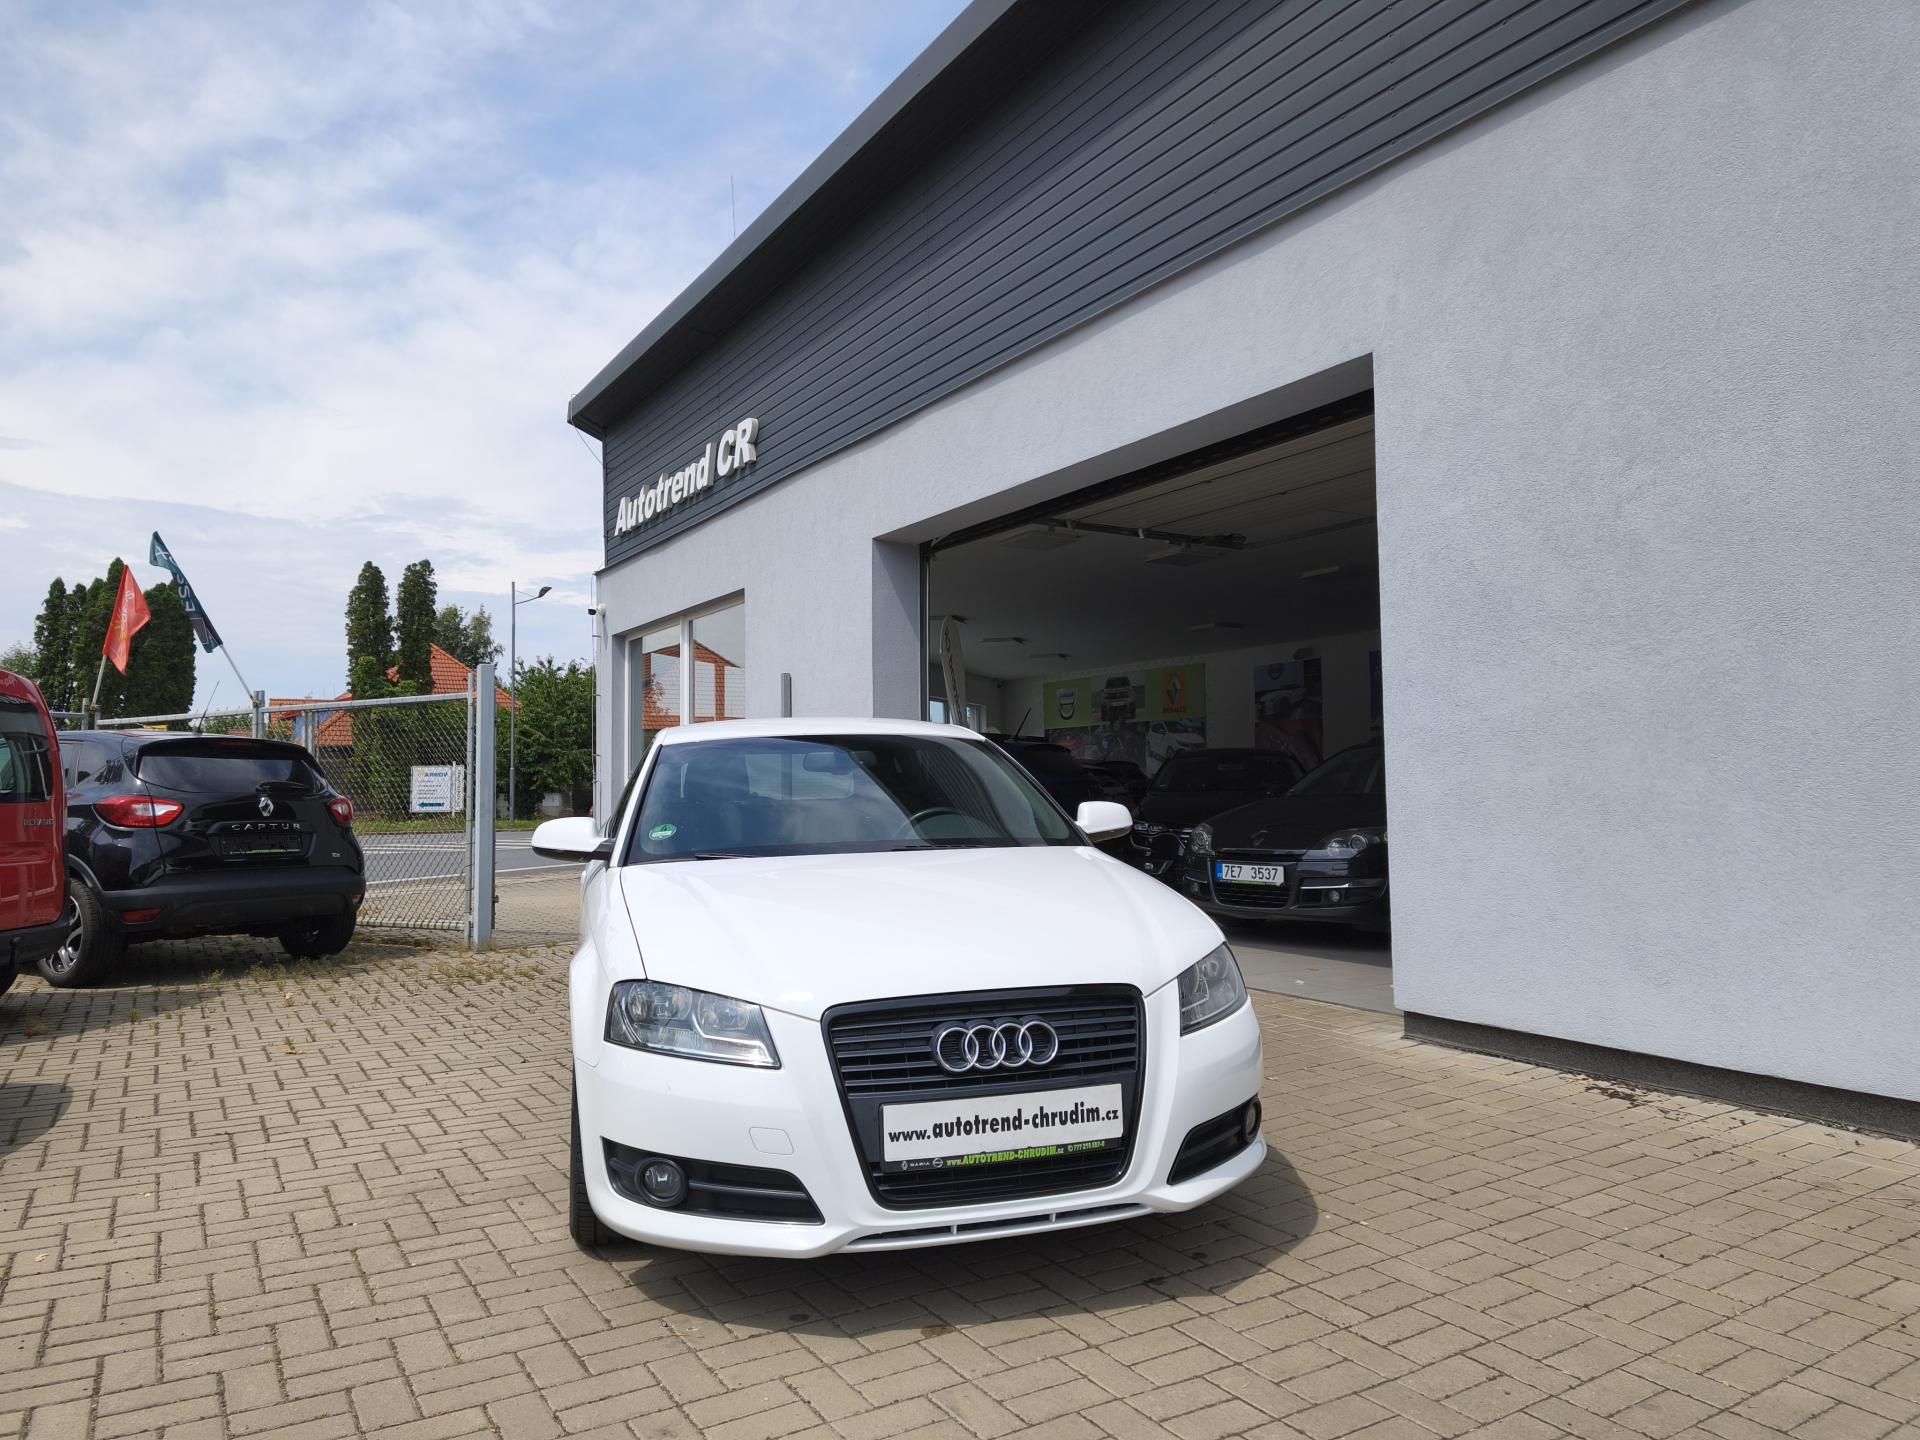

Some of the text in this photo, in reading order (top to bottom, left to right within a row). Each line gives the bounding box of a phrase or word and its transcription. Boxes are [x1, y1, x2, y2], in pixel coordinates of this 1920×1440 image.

[614, 417, 760, 537] Autotrend CR
[231, 823, 301, 831] CAPTUR
[1224, 865, 1278, 881] 7E7 3537
[888, 1101, 1119, 1142] www.autotrend-chrudim.cz
